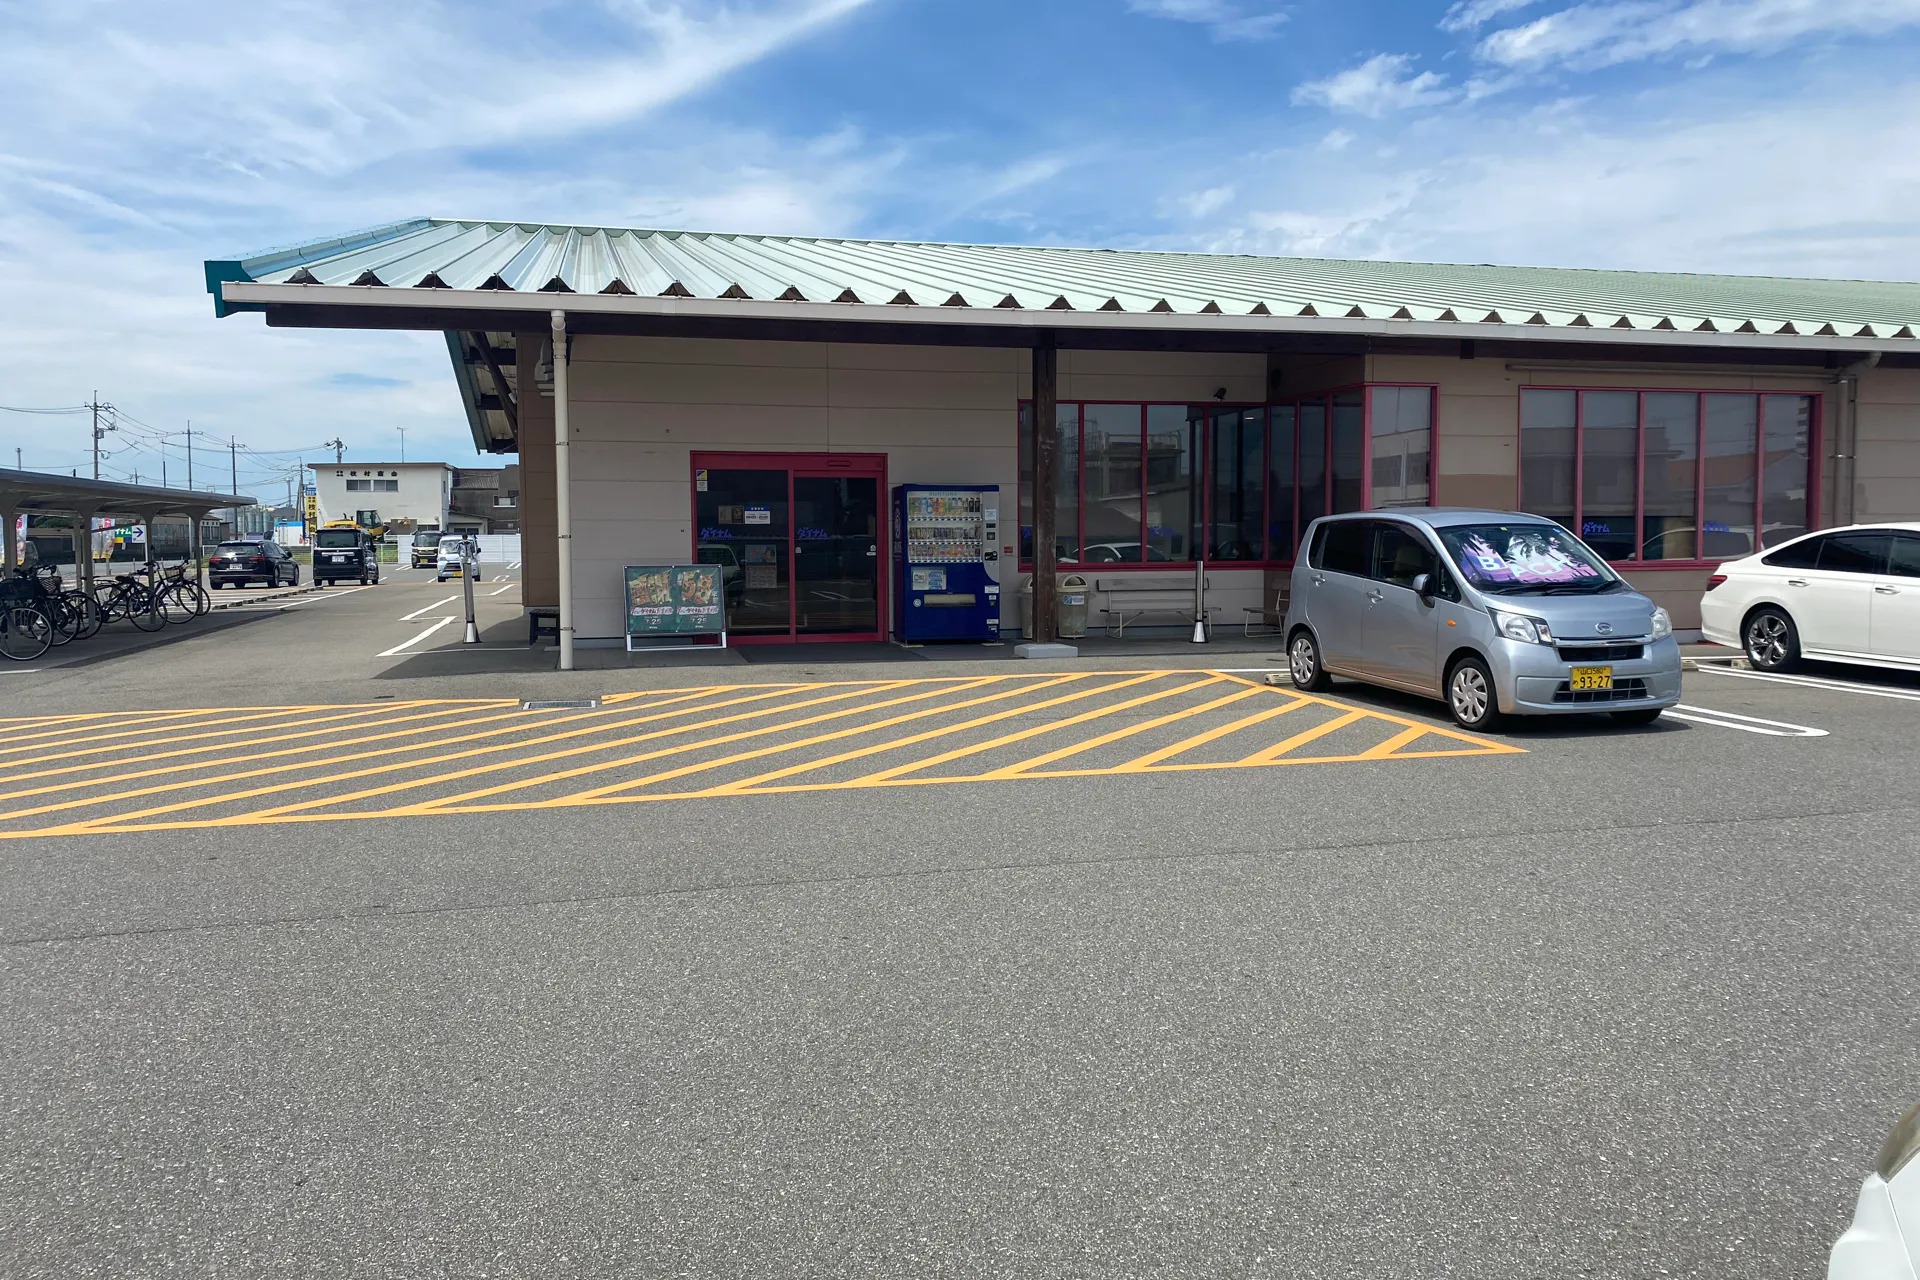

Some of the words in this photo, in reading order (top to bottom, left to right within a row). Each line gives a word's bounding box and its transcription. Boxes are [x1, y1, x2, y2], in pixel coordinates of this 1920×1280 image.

[701, 527, 733, 540] ダイナム
[797, 527, 828, 540] ダイナム
[1583, 522, 1610, 534] ダイナム
[1580, 676, 1610, 689] 93-27
